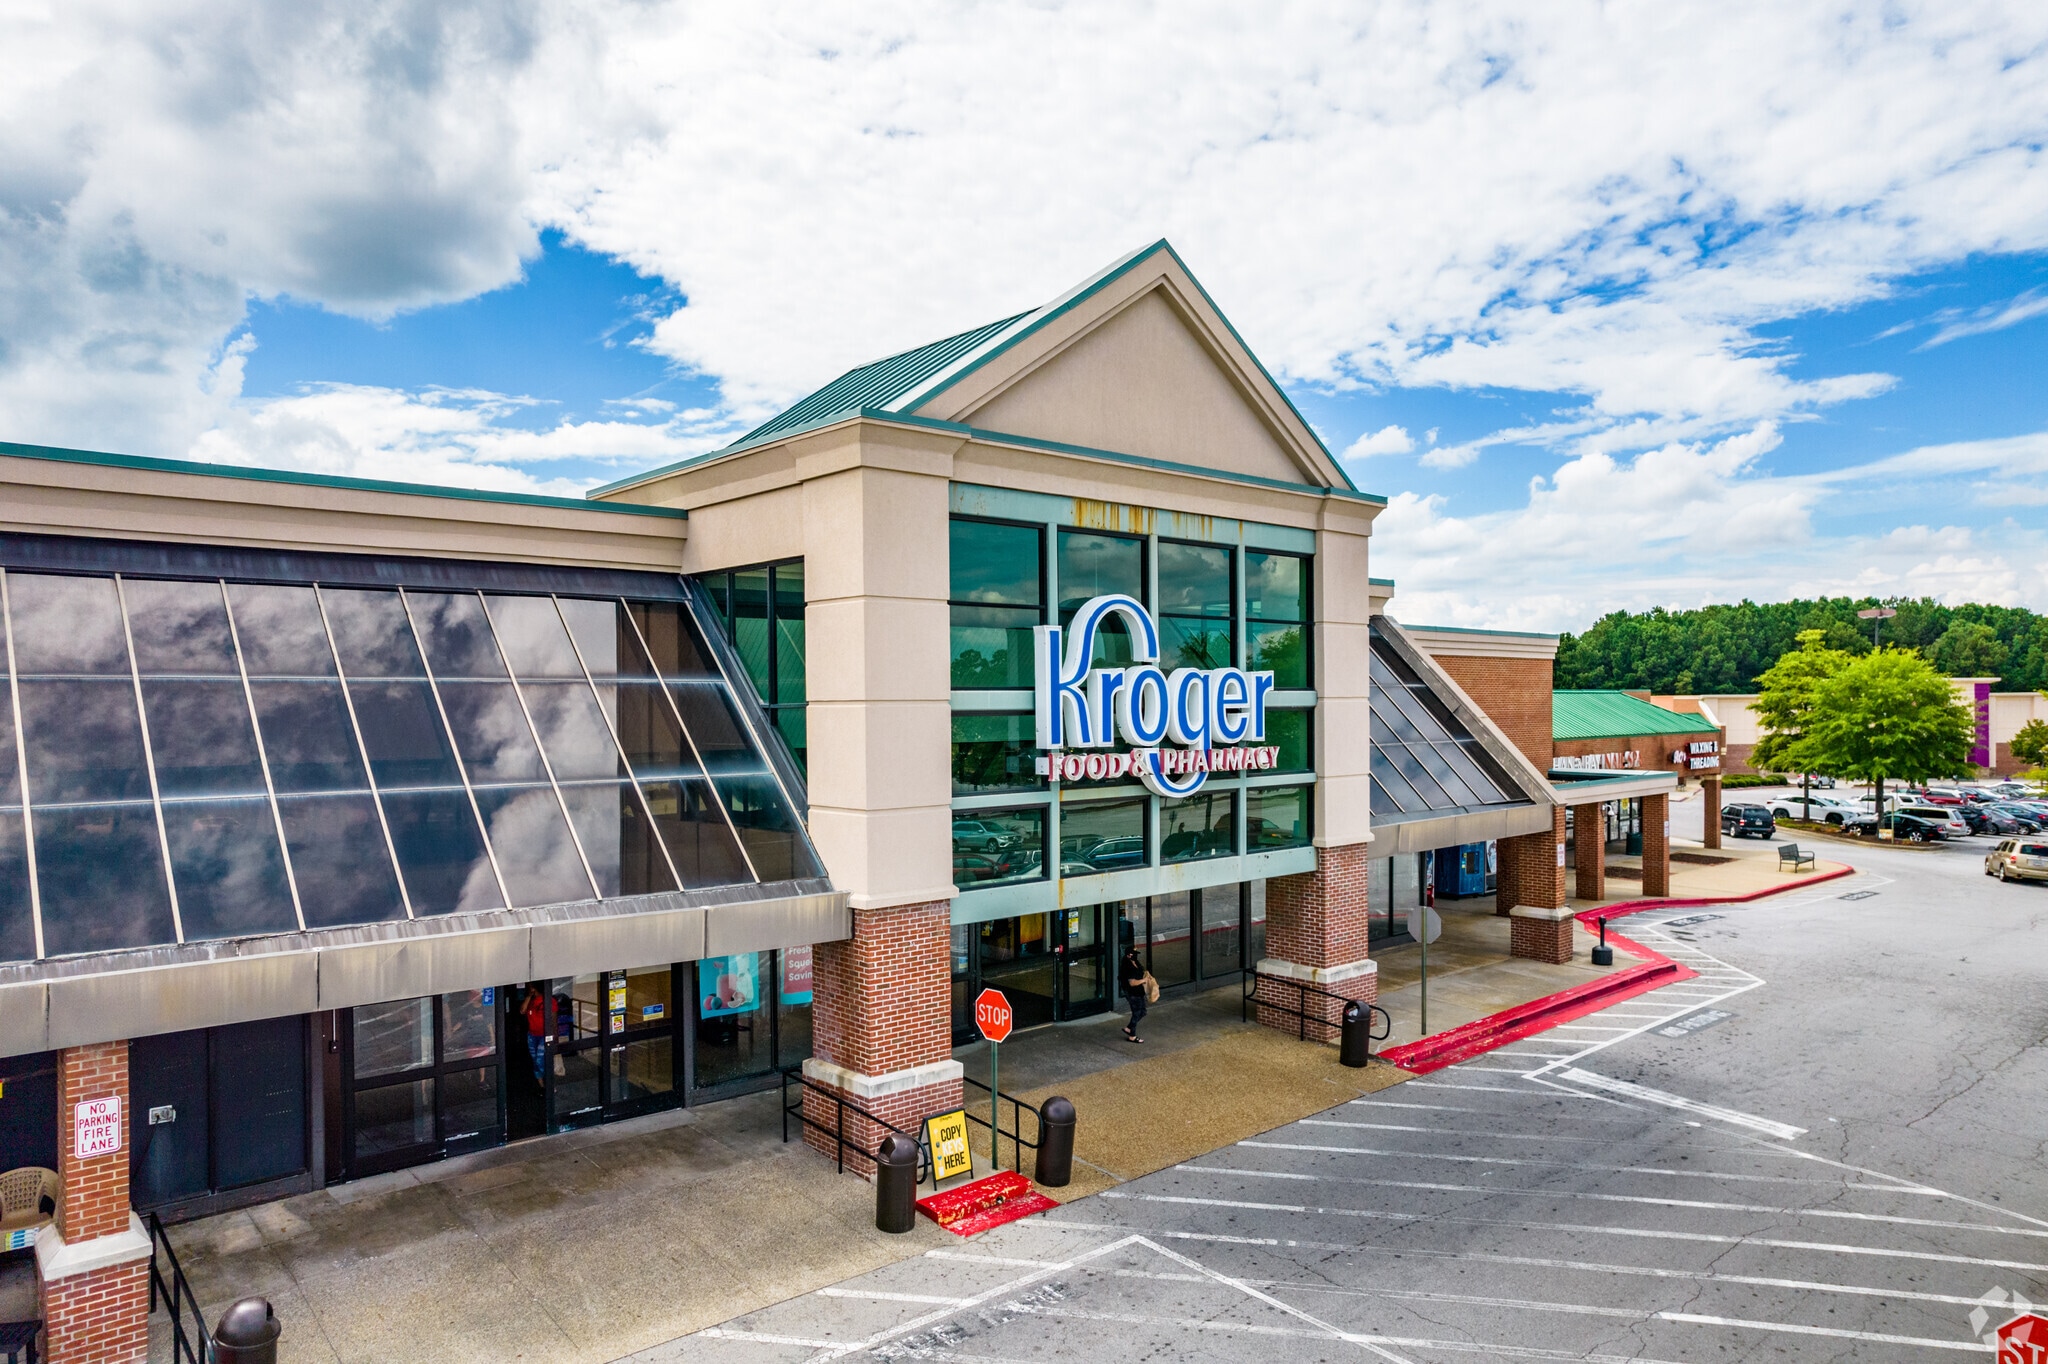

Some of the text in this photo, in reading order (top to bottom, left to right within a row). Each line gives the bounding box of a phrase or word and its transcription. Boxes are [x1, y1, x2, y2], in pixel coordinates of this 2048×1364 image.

[1033, 594, 1274, 798] Kroger
[1048, 746, 1280, 781] FOOD & PHARMACY
[978, 1003, 1010, 1027] STOP
[90, 1103, 107, 1115] NO
[79, 1112, 118, 1129] PARKING
[84, 1125, 112, 1140] FIRE
[940, 1123, 962, 1142] COPY
[81, 1137, 114, 1153] LANE
[942, 1137, 965, 1156] KEYS
[944, 1151, 966, 1170] HERE
[2004, 1336, 2048, 1364] ST
